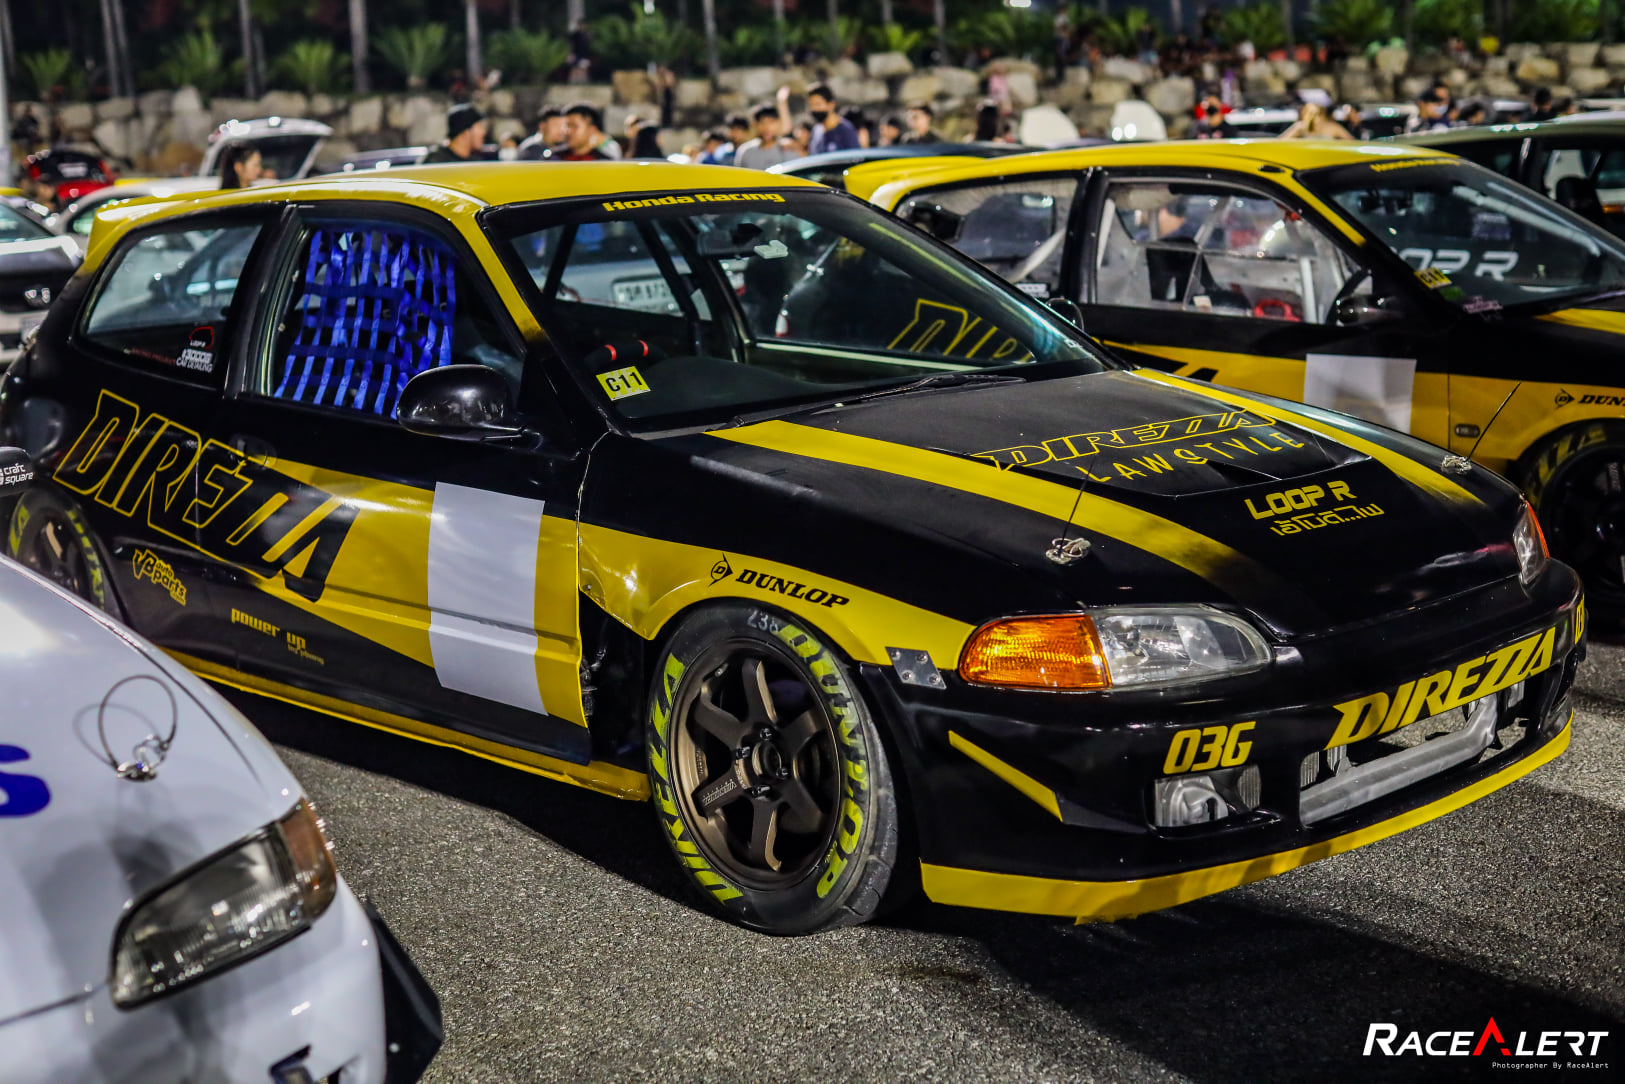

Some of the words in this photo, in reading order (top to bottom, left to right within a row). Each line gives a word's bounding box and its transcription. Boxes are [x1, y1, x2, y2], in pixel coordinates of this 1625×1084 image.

[602, 195, 696, 212] Honda
[694, 193, 786, 203] Racing
[1474, 250, 1519, 282] R
[605, 372, 643, 392] C11
[1578, 394, 1625, 407] DUN
[970, 407, 1277, 473] DIREZZA
[1075, 432, 1305, 483] LAWSTYLE
[4, 472, 34, 486] square
[1244, 484, 1326, 520] LOOP
[1326, 480, 1358, 502] R
[152, 569, 187, 598] parts
[735, 569, 850, 608] DUNLOP
[231, 608, 281, 638] power
[286, 631, 307, 650] up
[1323, 626, 1556, 751] DIREZZA
[1163, 720, 1256, 775] 03G
